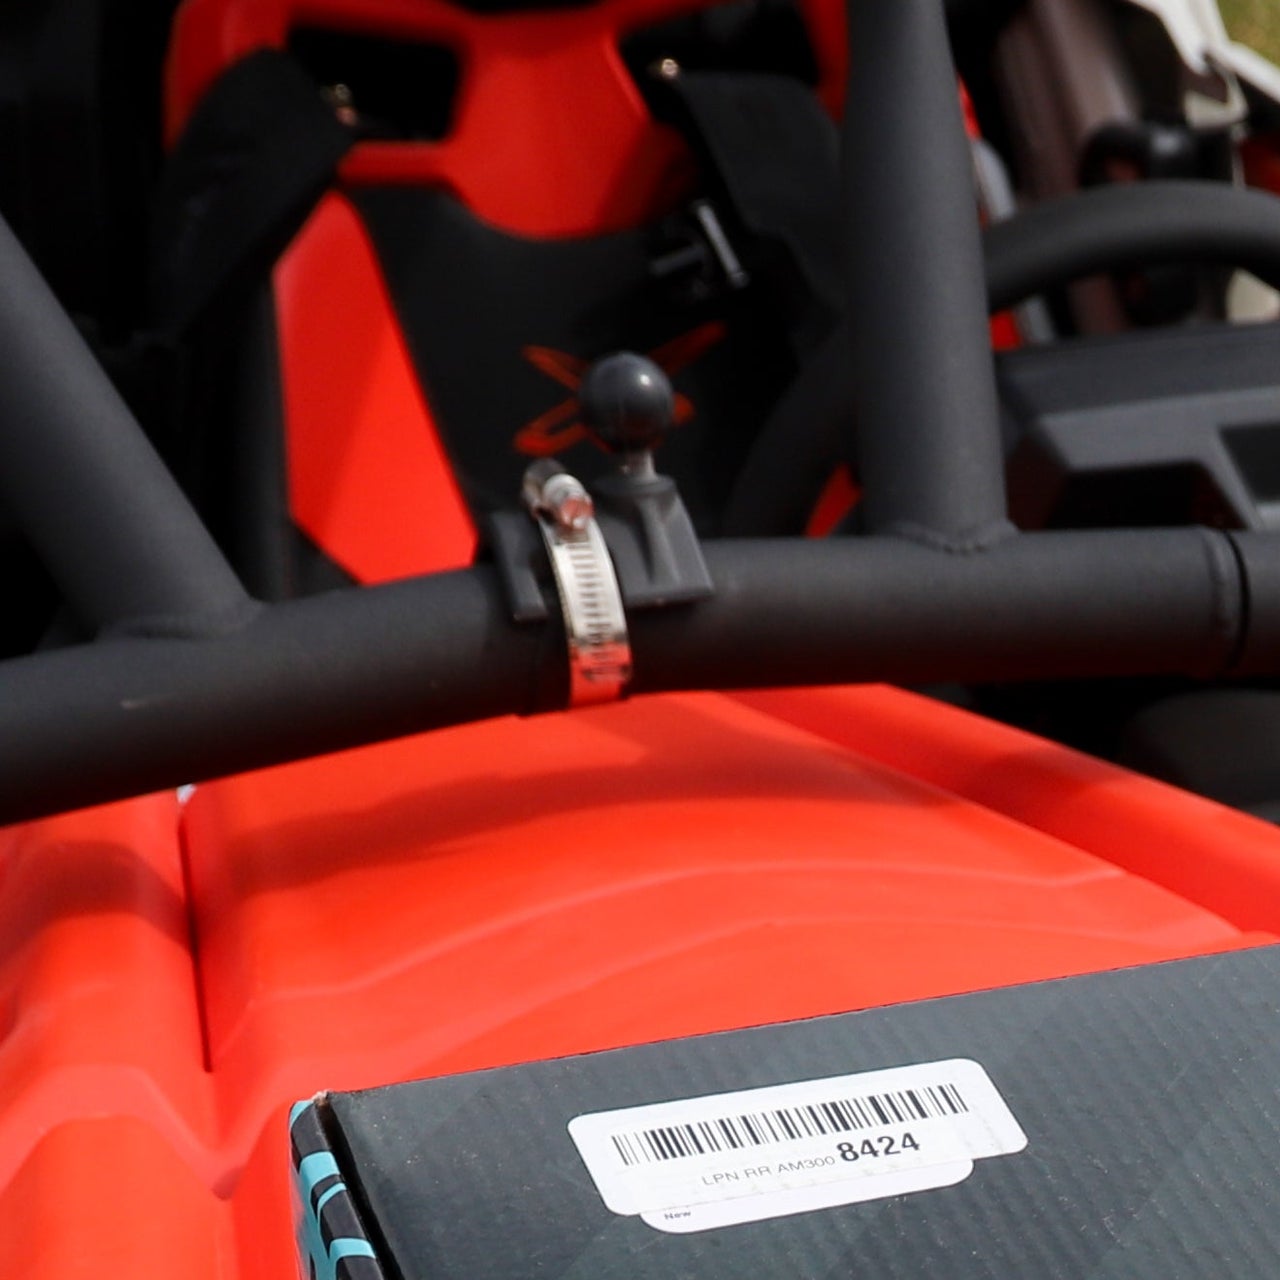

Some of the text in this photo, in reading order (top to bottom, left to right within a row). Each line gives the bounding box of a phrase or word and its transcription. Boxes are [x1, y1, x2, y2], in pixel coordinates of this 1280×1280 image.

[701, 1132, 920, 1187] LPN RR AM300 8424
